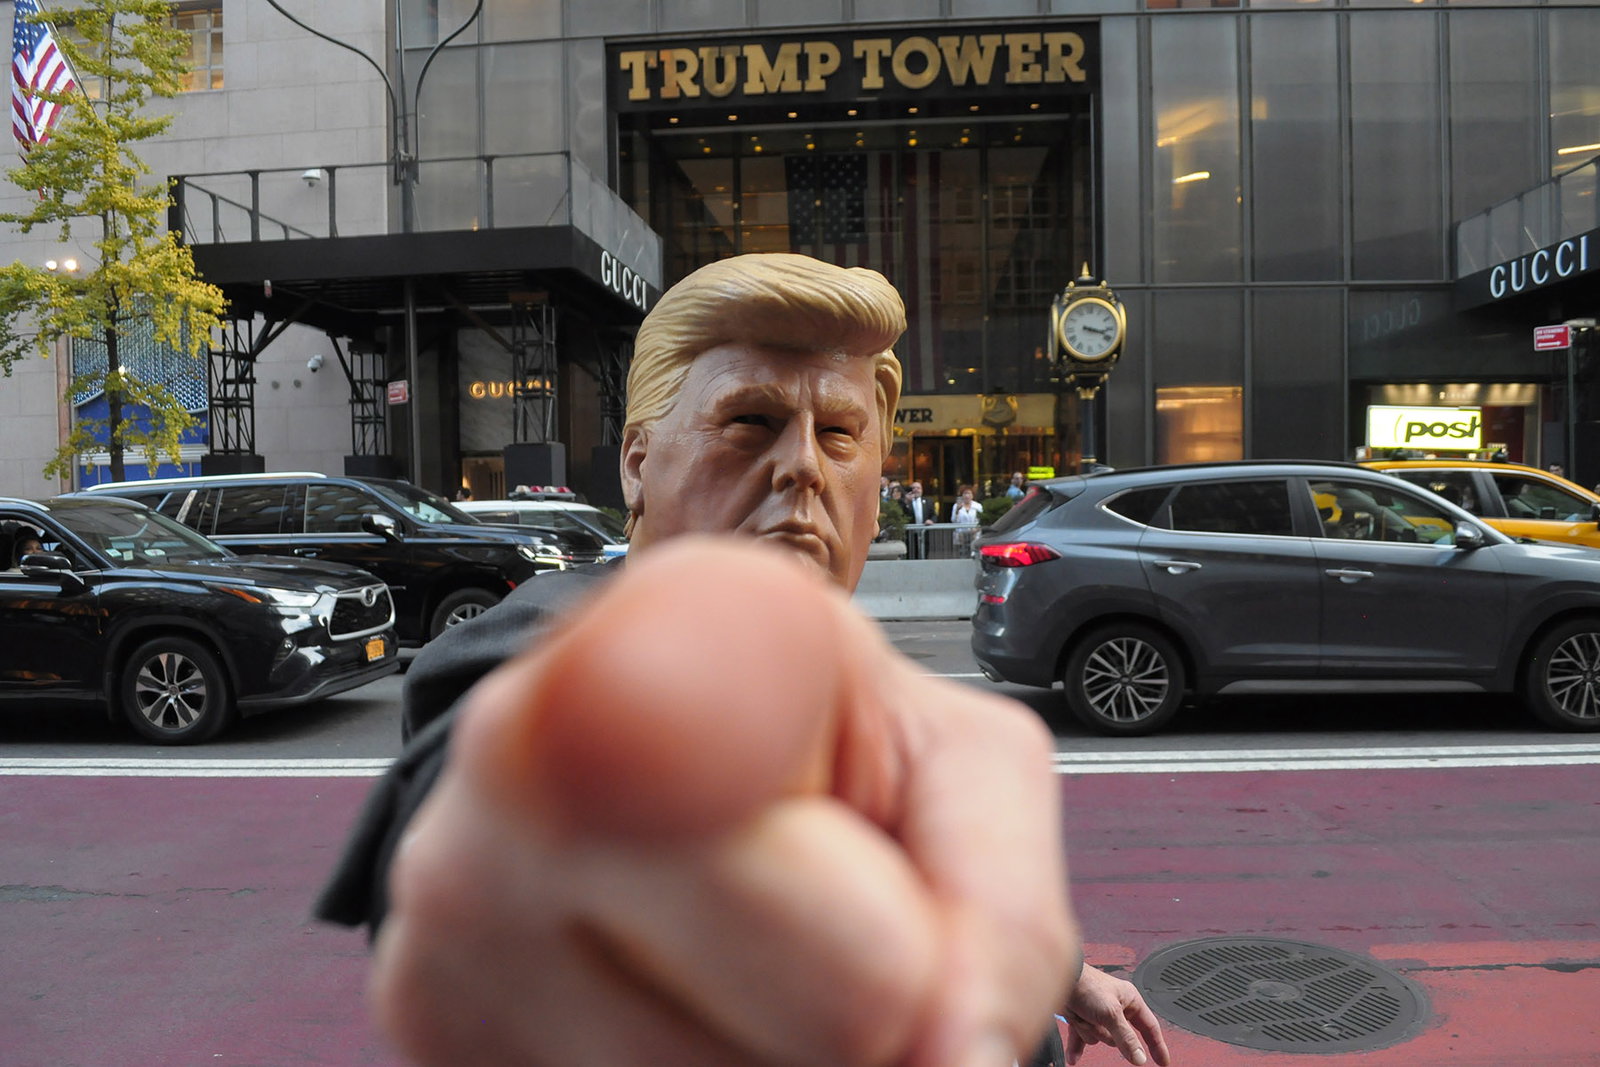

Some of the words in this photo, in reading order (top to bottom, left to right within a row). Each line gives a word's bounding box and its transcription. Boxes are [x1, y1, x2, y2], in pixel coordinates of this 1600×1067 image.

[620, 40, 841, 101] TRUMP
[853, 32, 1087, 90] TOWER
[601, 250, 648, 311] GUCCI
[1489, 235, 1589, 299] GUCCI
